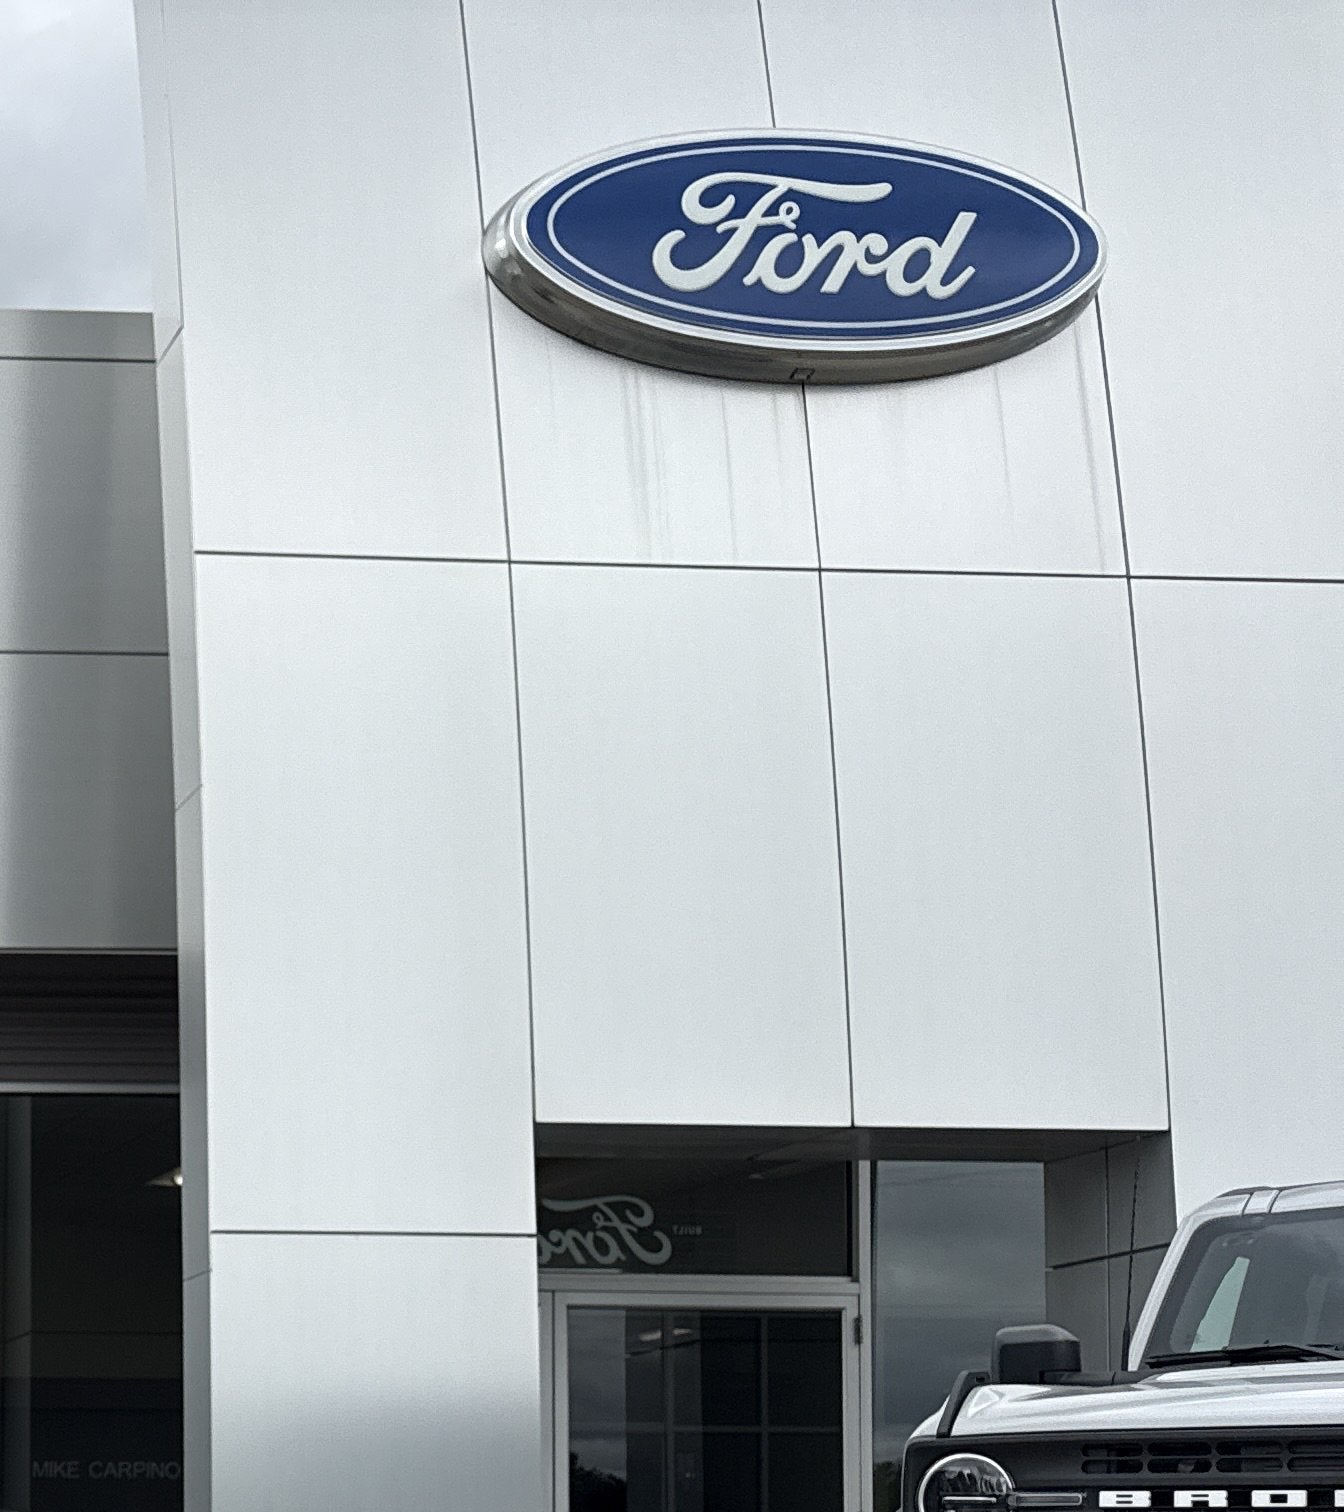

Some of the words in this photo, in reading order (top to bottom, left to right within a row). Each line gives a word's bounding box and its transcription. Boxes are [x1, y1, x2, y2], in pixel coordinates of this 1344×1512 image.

[652, 172, 977, 300] Ford
[32, 1460, 80, 1479] MIKE
[88, 1460, 181, 1480] CARPINO
[1098, 1489, 1344, 1508] BRO
